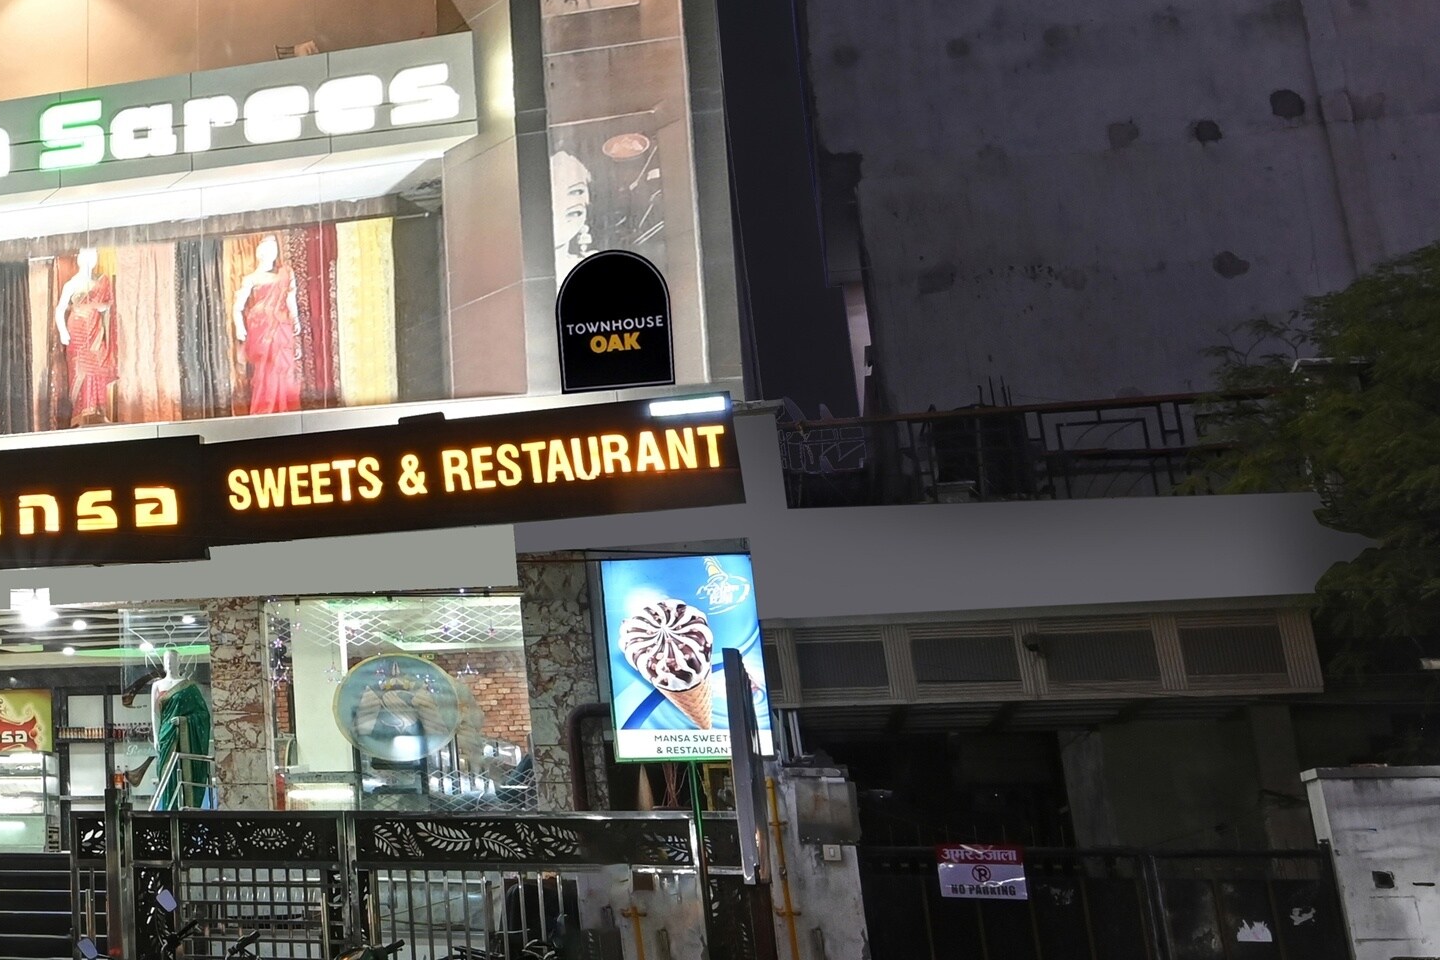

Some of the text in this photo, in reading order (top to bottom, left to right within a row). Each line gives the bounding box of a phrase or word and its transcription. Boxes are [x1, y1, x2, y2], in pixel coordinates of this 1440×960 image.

[39, 62, 461, 170] Sarees
[566, 315, 664, 335] TOWNHOUSE
[590, 332, 641, 354] OAK
[228, 425, 725, 511] SWEETS & RESTAURANT
[656, 746, 663, 754] &
[951, 884, 1016, 896] NO PARKING
